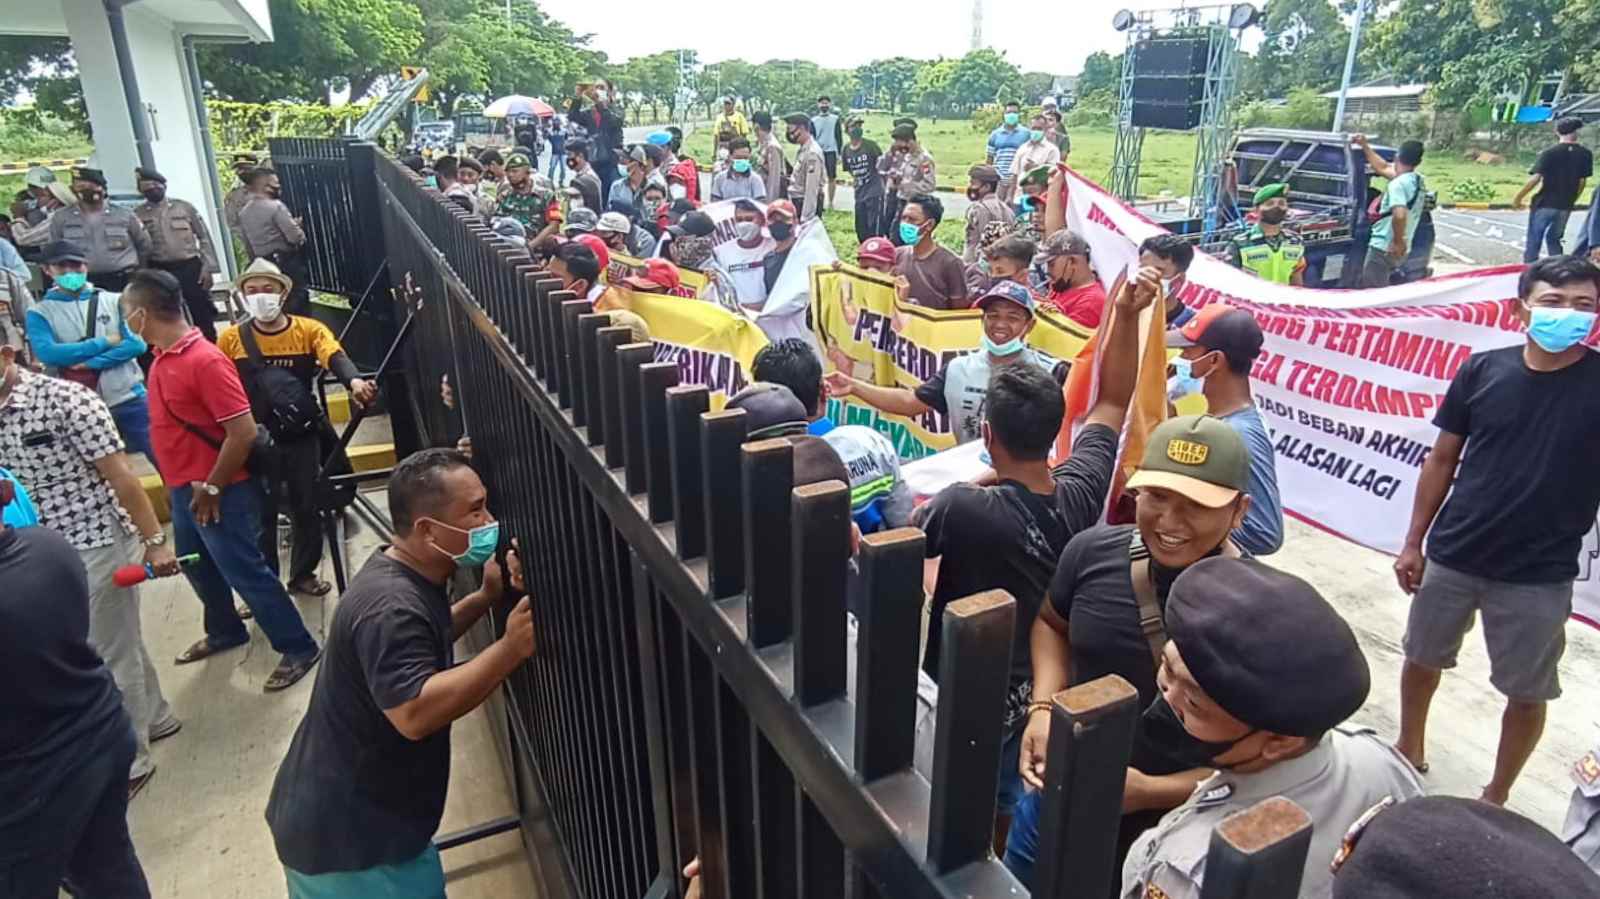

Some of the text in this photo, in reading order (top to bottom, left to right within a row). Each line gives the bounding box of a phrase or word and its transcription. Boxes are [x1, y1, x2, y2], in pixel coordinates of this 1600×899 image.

[1298, 408, 1365, 444] BEBAN
[1275, 434, 1402, 500] ALASAN LAGI
